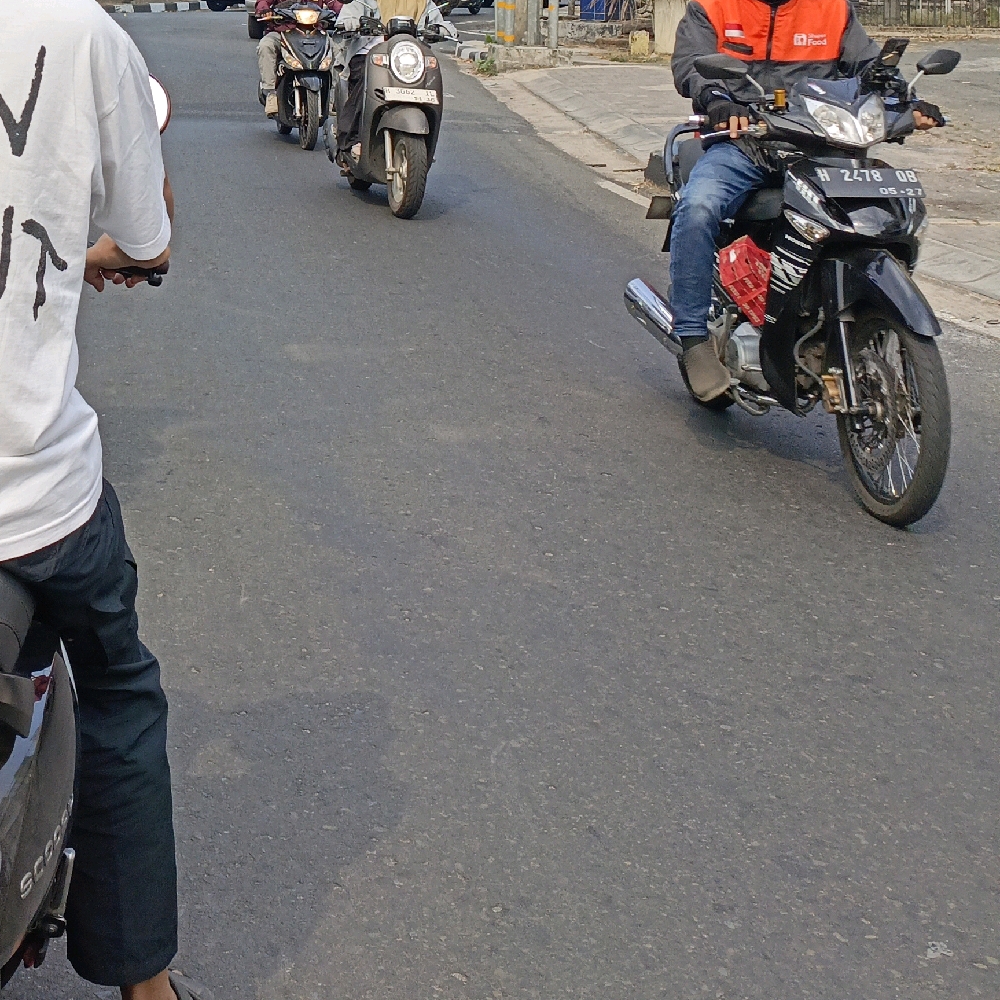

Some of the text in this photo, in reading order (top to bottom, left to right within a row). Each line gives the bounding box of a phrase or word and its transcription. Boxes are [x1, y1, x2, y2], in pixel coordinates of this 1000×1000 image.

[807, 38, 827, 46] Food
[815, 167, 831, 182] H
[840, 169, 884, 182] 2478
